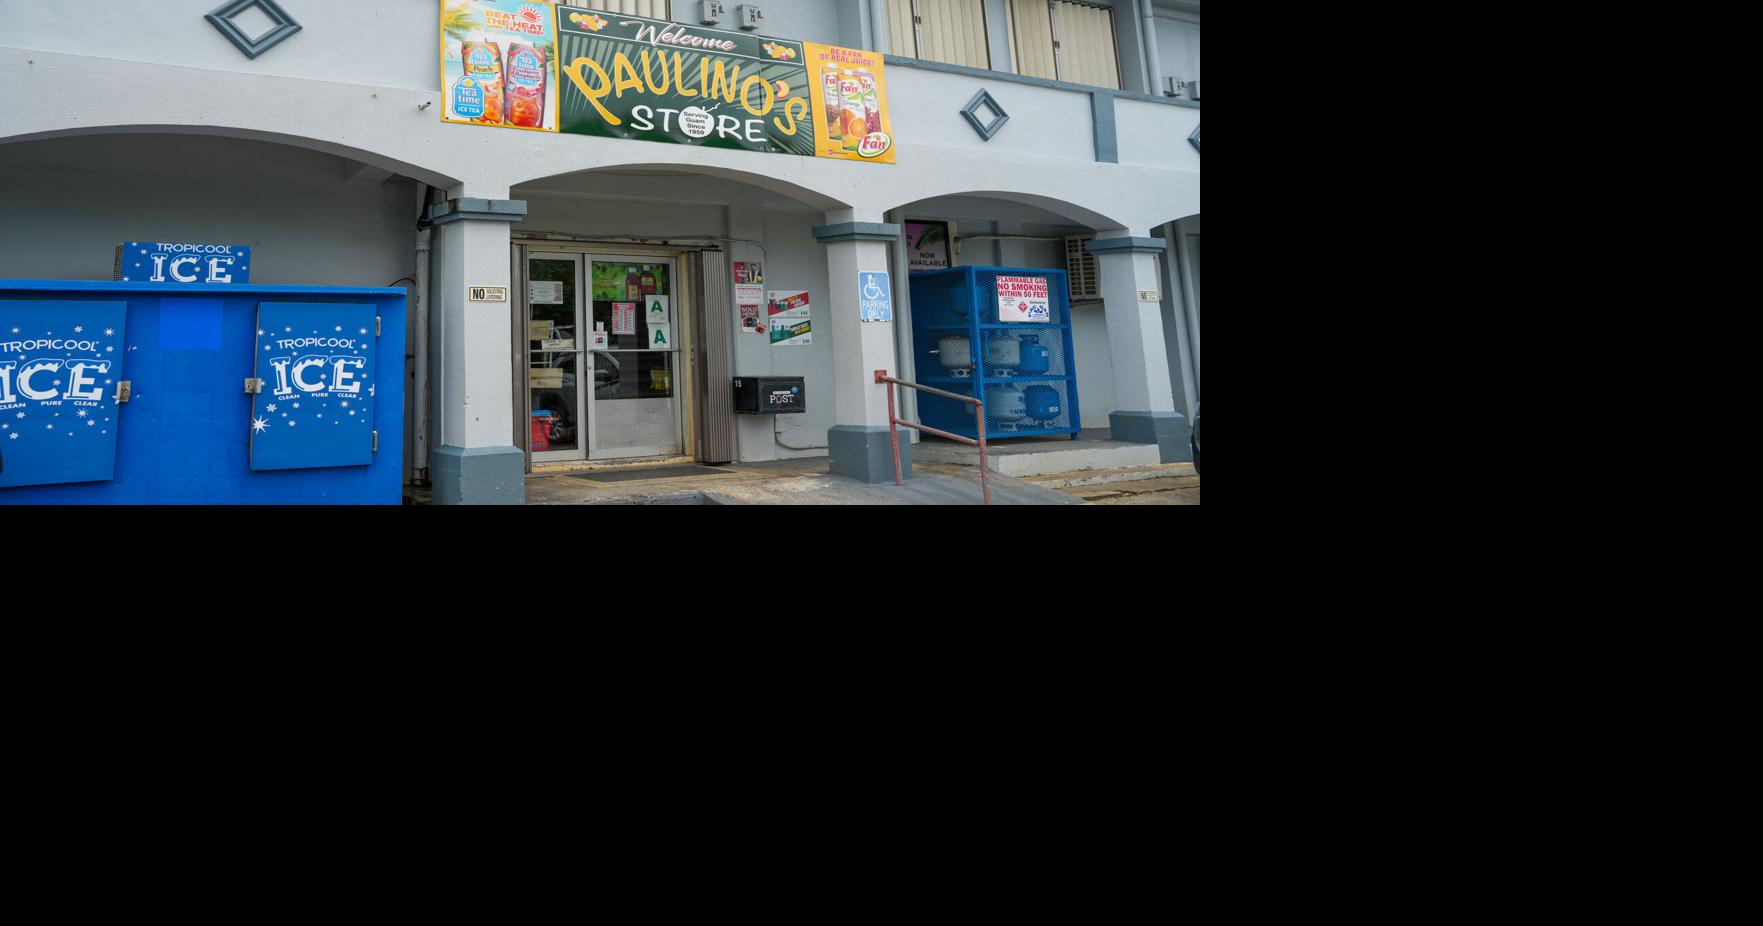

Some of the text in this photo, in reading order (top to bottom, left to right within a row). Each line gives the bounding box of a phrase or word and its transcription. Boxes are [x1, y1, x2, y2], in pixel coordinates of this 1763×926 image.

[485, 10, 518, 20] BEAT
[486, 17, 544, 31] THE HEAT
[619, 20, 737, 51] Welcome
[831, 55, 849, 63] REAL
[850, 57, 874, 66] JUICE!
[461, 88, 477, 97] Tea
[840, 81, 858, 93] Fan
[458, 94, 480, 104] time
[683, 111, 709, 119] Serving
[862, 135, 886, 150] Fan
[150, 253, 235, 283] ICE
[472, 288, 485, 300] NO
[650, 300, 663, 312] A
[862, 300, 888, 310] PARKING
[867, 309, 884, 319] ONLY
[653, 329, 667, 344] A
[0, 357, 111, 403] ICE
[270, 354, 366, 395] ICE
[769, 394, 794, 404] POST
[0, 402, 26, 410] CLEAN
